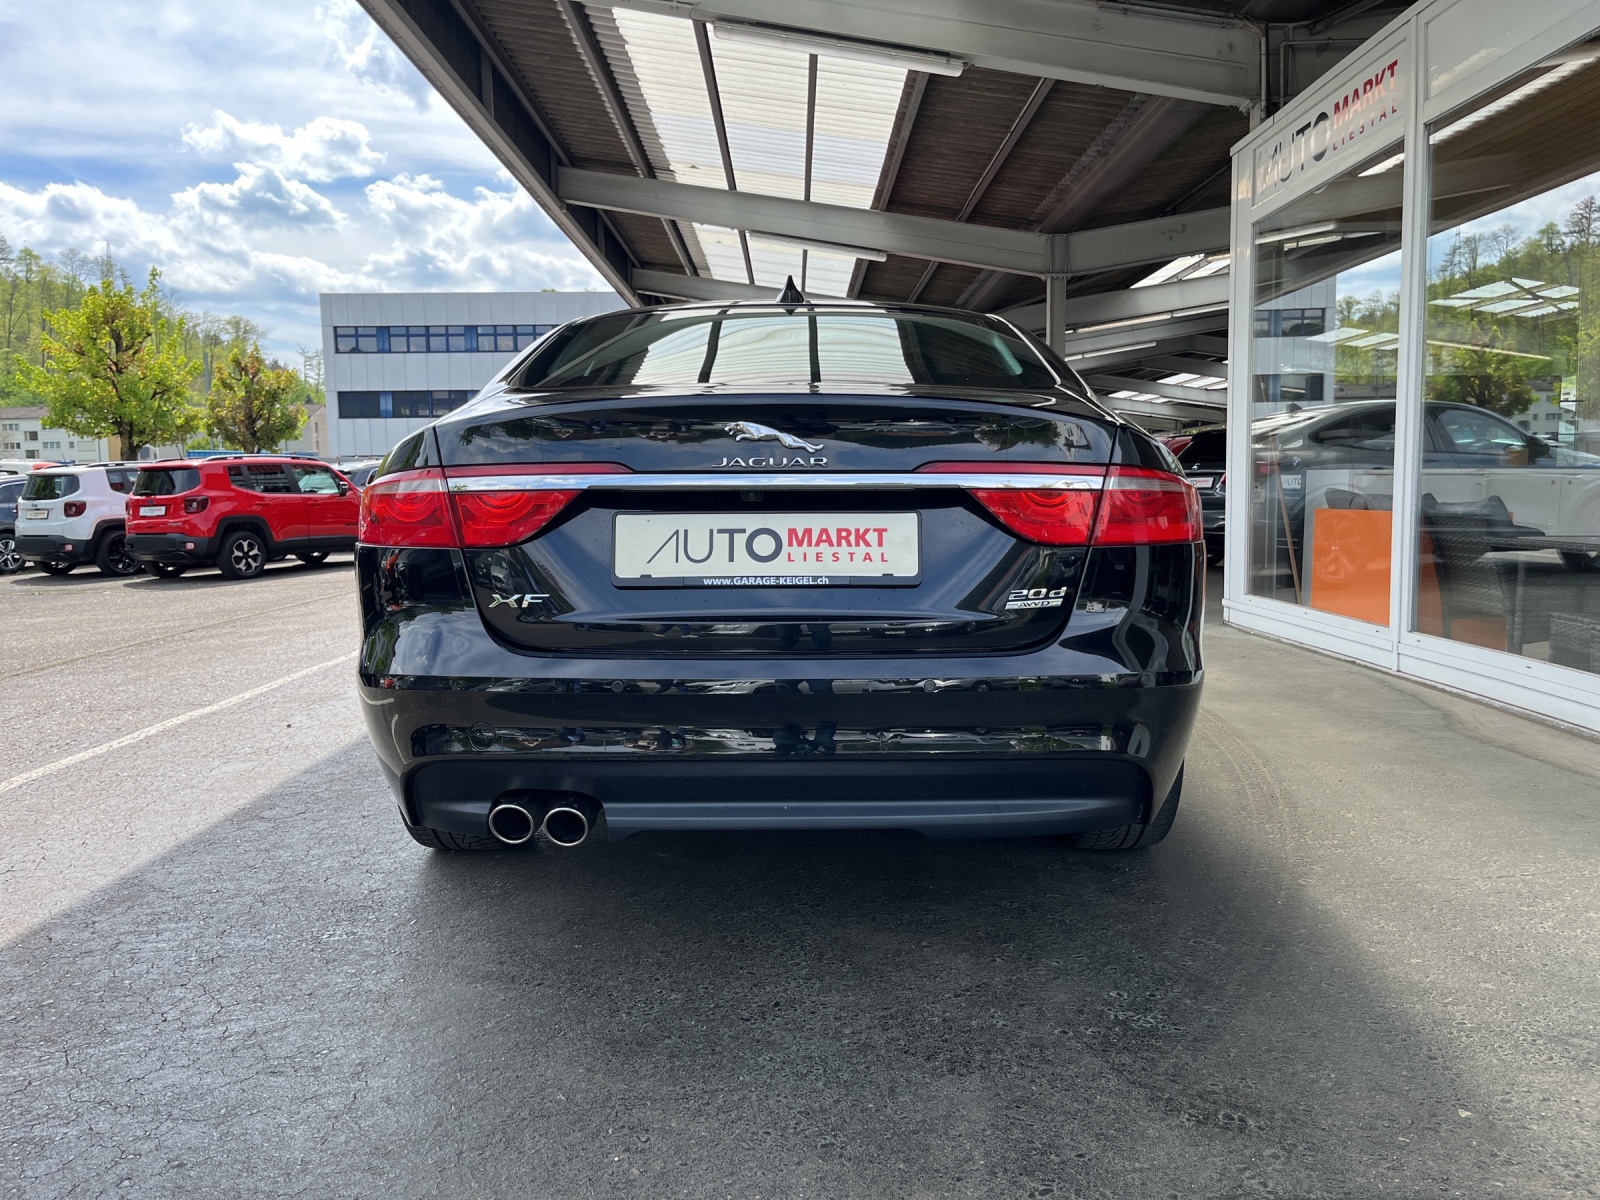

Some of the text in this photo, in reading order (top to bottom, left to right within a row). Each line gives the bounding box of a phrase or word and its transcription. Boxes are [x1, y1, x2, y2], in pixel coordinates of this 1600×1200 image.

[1260, 59, 1398, 196] AUTO MARKT
[1332, 98, 1397, 151] LIESTAL
[711, 456, 828, 468] JAGUAR
[646, 527, 889, 564] AUTO MARKT
[787, 552, 889, 563] LIESTAL
[703, 576, 829, 586] www.GARAGE-KEIGEL.ch
[1008, 586, 1068, 600] 20d
[488, 593, 551, 608] XF
[1018, 600, 1051, 608] AWD
